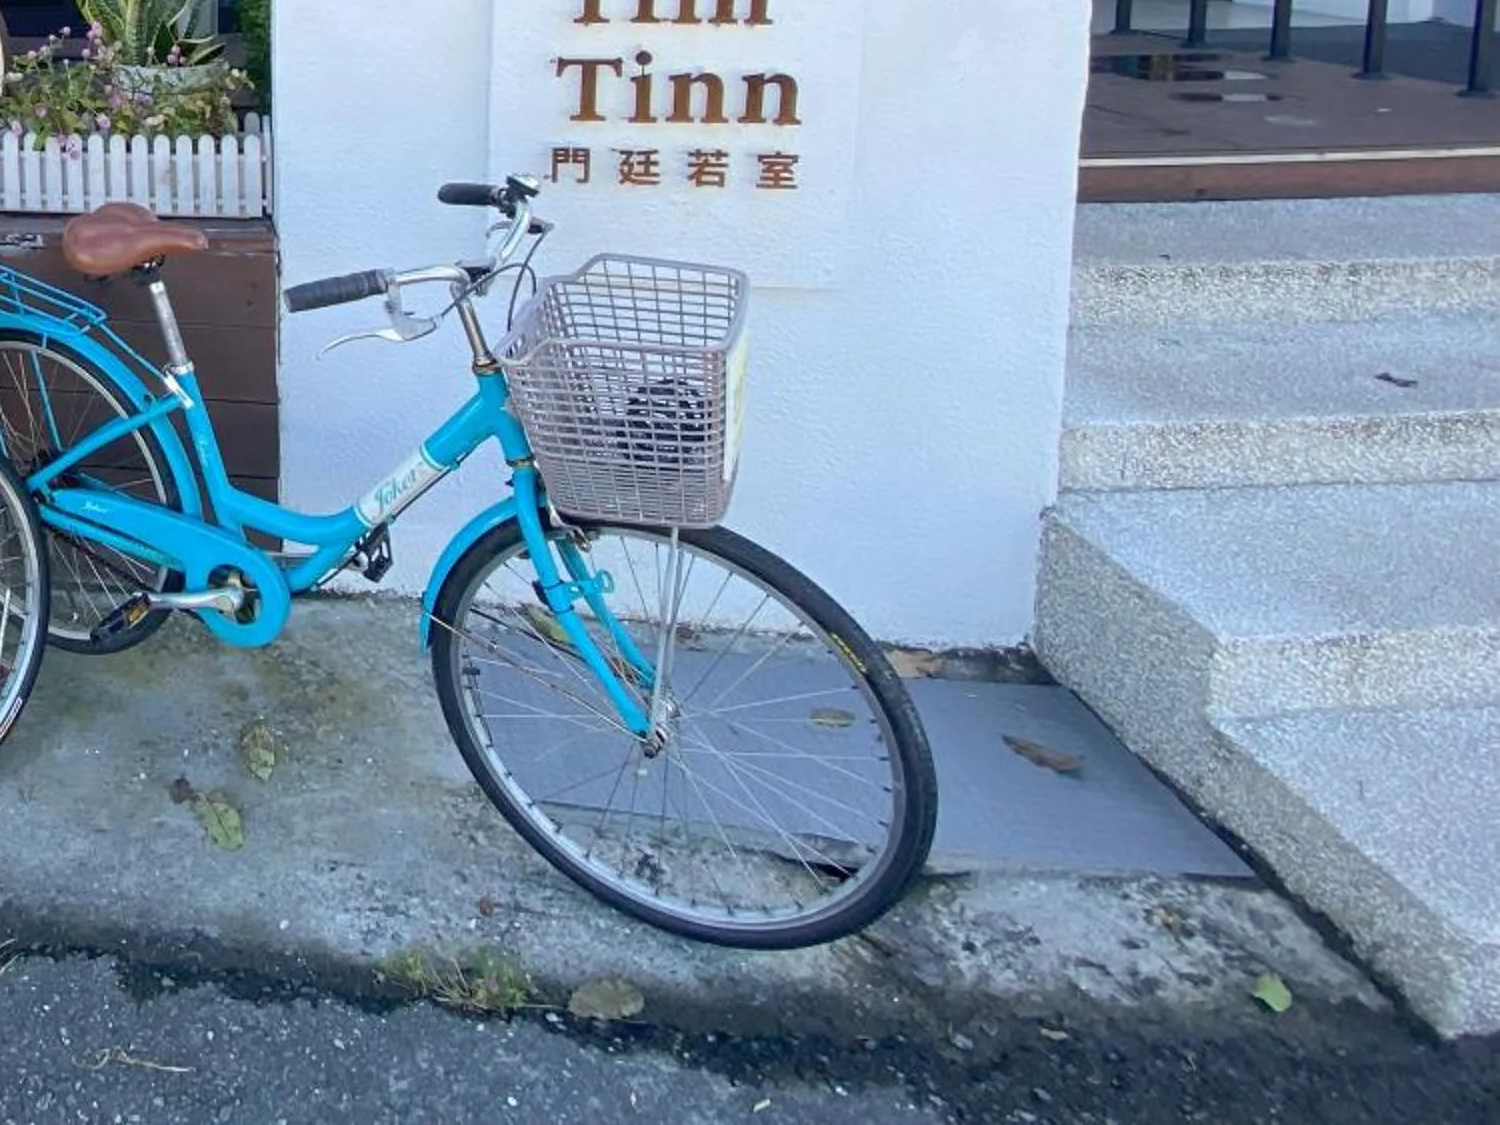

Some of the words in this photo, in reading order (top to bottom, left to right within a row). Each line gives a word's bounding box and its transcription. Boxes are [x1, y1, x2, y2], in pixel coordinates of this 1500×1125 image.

[555, 49, 802, 126] Tinn
[550, 146, 800, 190] 門廷若室
